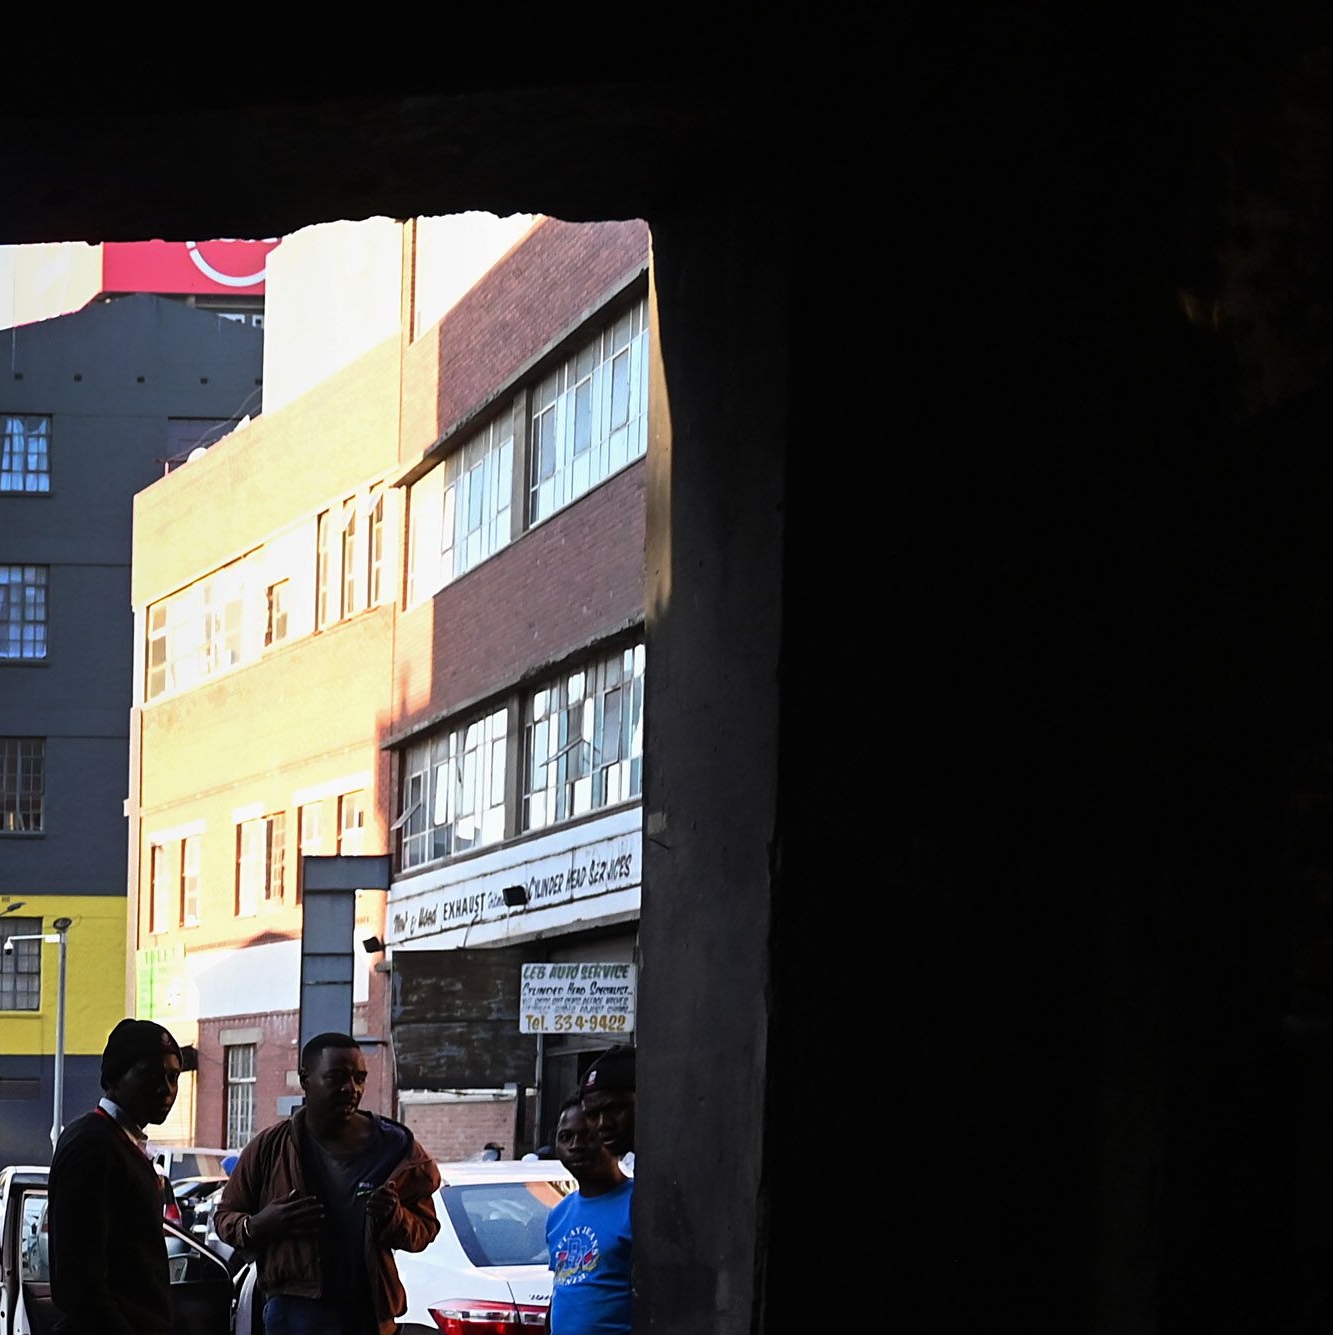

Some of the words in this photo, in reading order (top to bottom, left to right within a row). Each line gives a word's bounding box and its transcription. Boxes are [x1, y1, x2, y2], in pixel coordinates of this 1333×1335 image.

[528, 876, 564, 900] CYLINDER
[565, 866, 587, 892] HEAD
[443, 893, 486, 921] EXHAUST
[549, 965, 579, 979] AUTO
[581, 964, 630, 979] SERVICE
